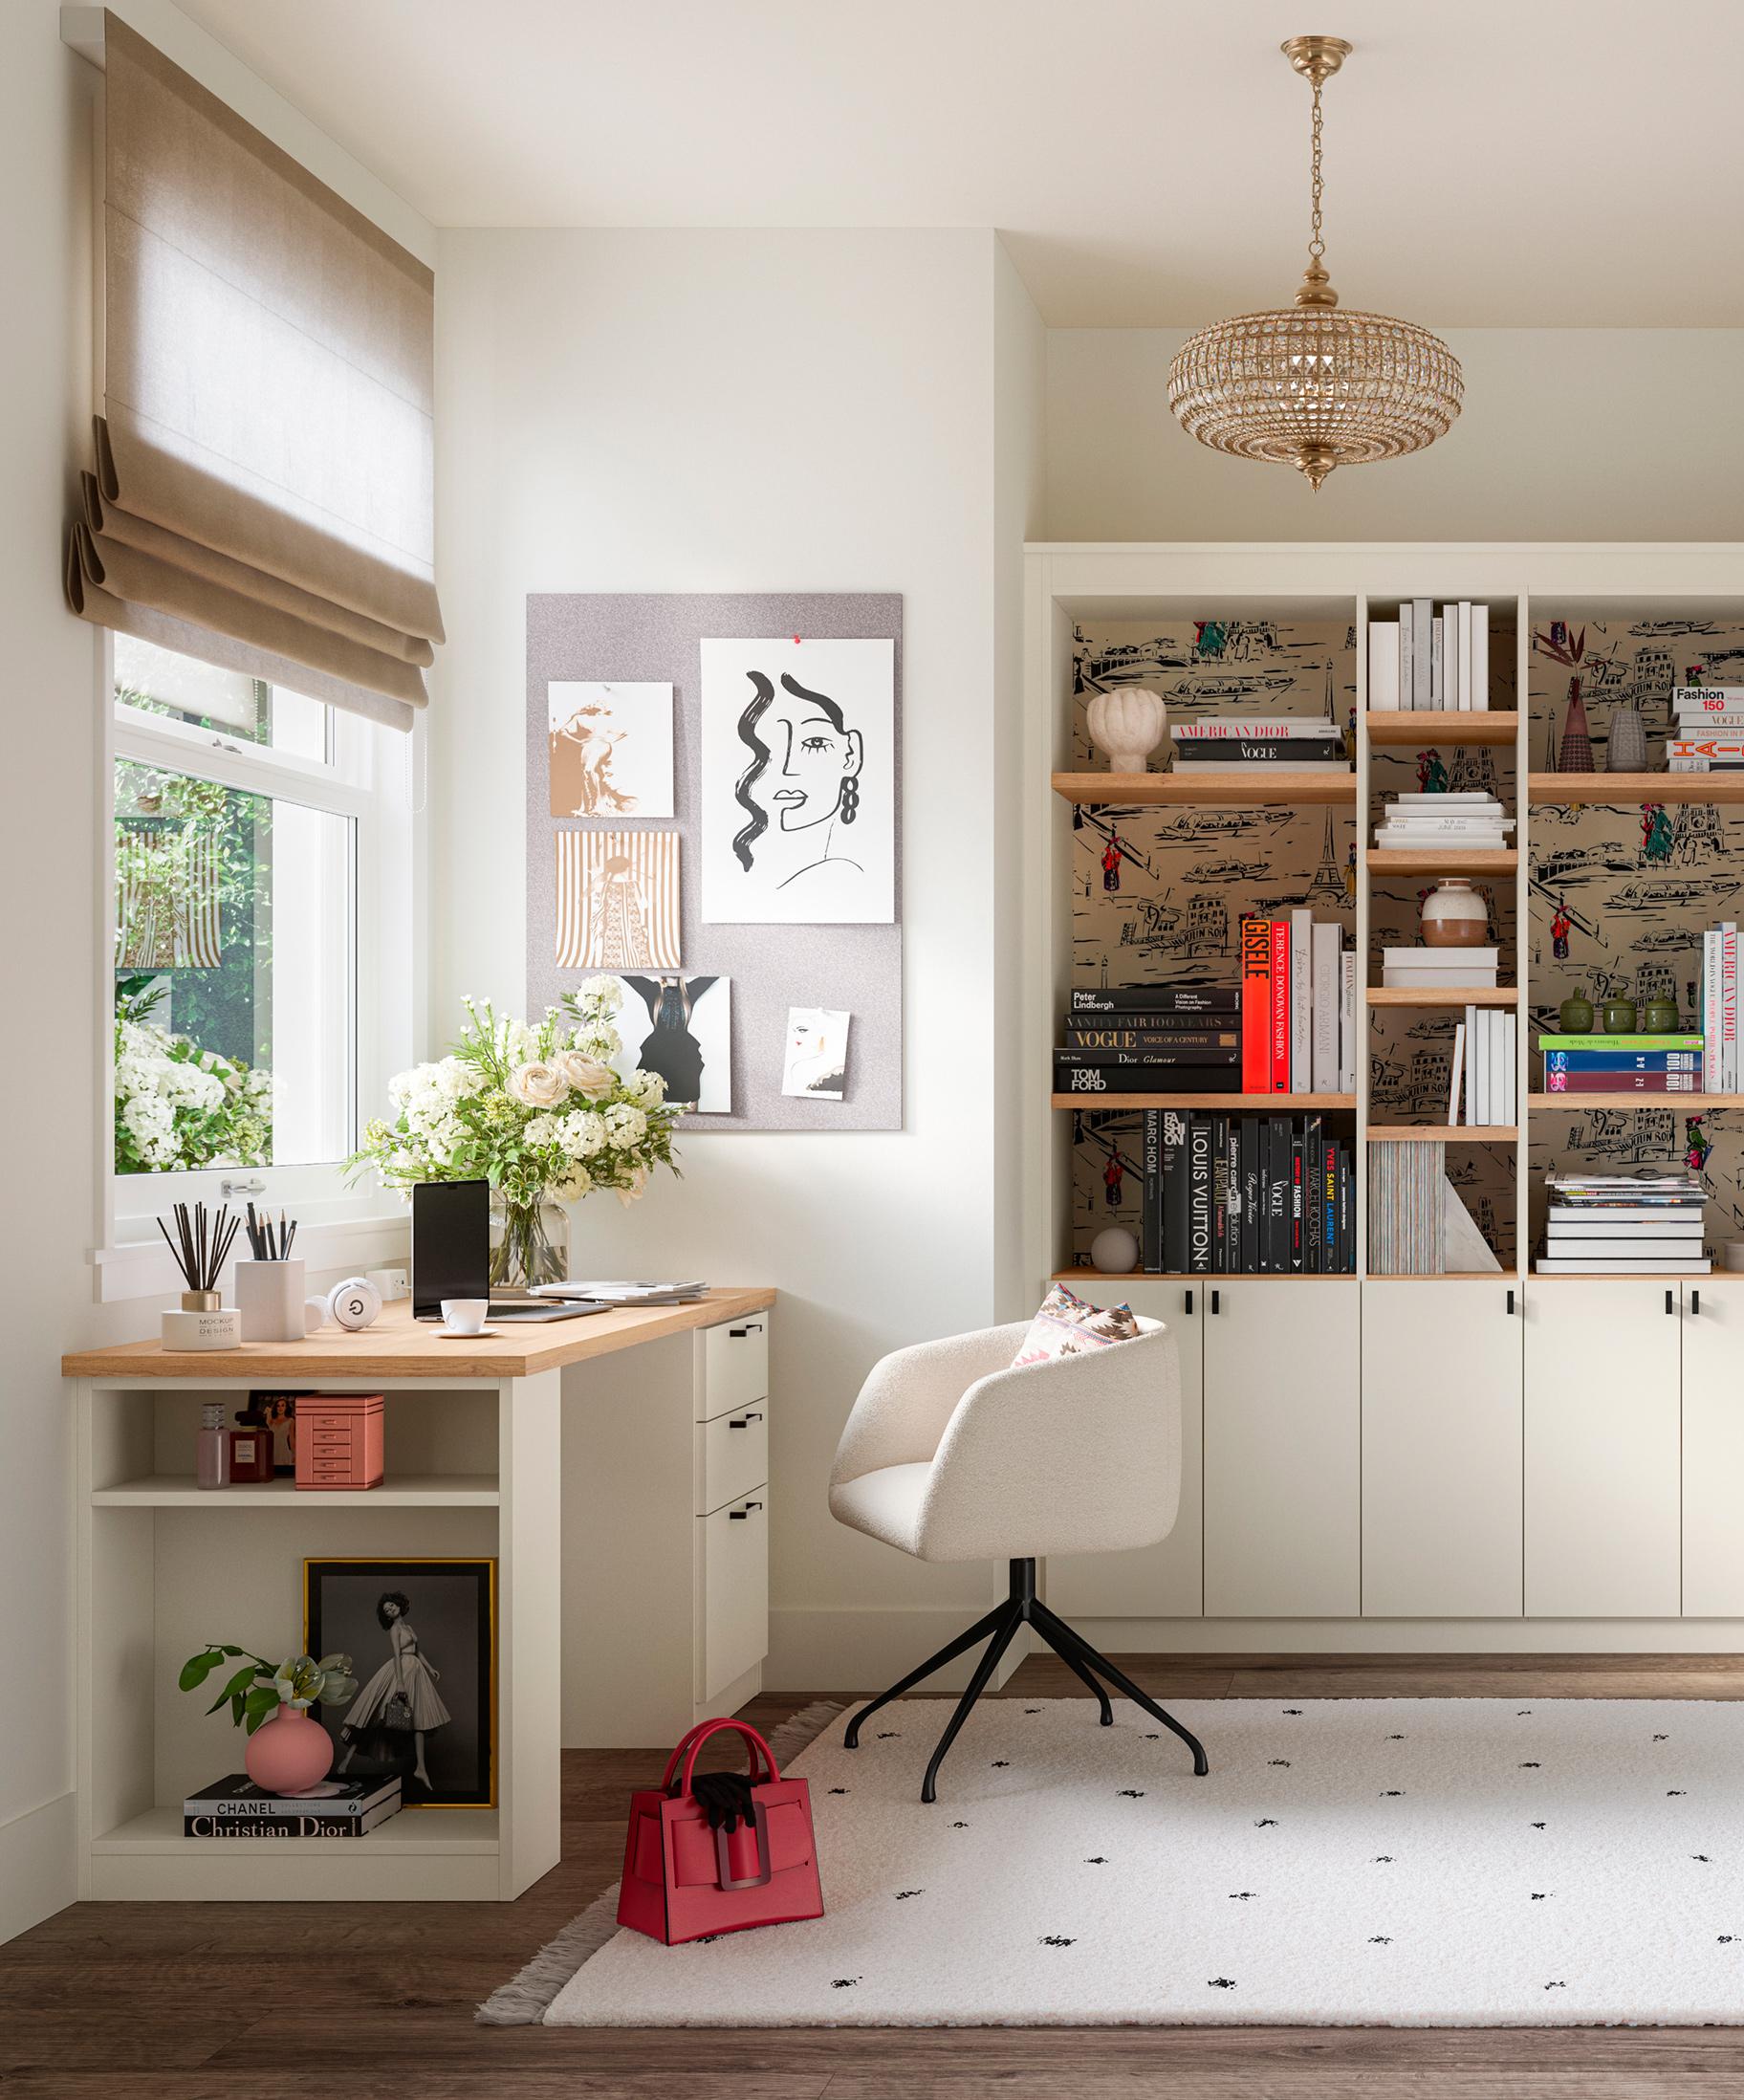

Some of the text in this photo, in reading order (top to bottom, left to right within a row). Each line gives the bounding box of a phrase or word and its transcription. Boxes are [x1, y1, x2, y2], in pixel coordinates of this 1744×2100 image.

[1677, 689, 1724, 700] Fashion
[1703, 700, 1724, 711] 150
[1179, 726, 1290, 737] AMERICAN DIOR
[1241, 741, 1277, 759] VOGUE
[1673, 741, 1744, 757] HAI
[1245, 921, 1270, 979] GISELE
[1275, 926, 1285, 1060] TERENCE DONOVAN FASHION
[1724, 931, 1735, 1041] AMERICAN DIOR
[1074, 993, 1096, 1001] Peter
[1074, 1001, 1114, 1011] Lindbergh
[1319, 964, 1331, 1054] GIORGIO ARMANI
[1067, 1017, 1112, 1028] VANITY
[1118, 1017, 1147, 1028] FAIR
[1178, 1017, 1222, 1028] YEARS
[1076, 1031, 1137, 1048] VOGUE
[1119, 1054, 1176, 1063] Dior Glamour
[1666, 1053, 1680, 1071] 100
[1071, 1069, 1100, 1081] TOM
[1071, 1080, 1106, 1091] FORD
[1666, 1074, 1680, 1092] 100
[1146, 1110, 1157, 1173] MARC HOM
[1192, 1131, 1208, 1180] LOUIS
[1326, 1147, 1335, 1170] YVES
[1229, 1137, 1240, 1246] pierre cardin evolution
[1309, 1167, 1320, 1204] MARCEL
[1326, 1173, 1335, 1200] SAINT
[1244, 1172, 1257, 1224] Roger Vivier
[1272, 1180, 1289, 1216] VOGUE
[1293, 1186, 1301, 1217] FASHION
[1192, 1185, 1208, 1261] VUITTON
[1309, 1206, 1320, 1247] ROCHAS
[1326, 1202, 1335, 1245] LAURENT
[199, 1326, 233, 1335] DESIGN
[217, 1803, 276, 1815] CHANEL
[191, 1816, 289, 1837] Christian
[298, 1816, 347, 1837] Dior
